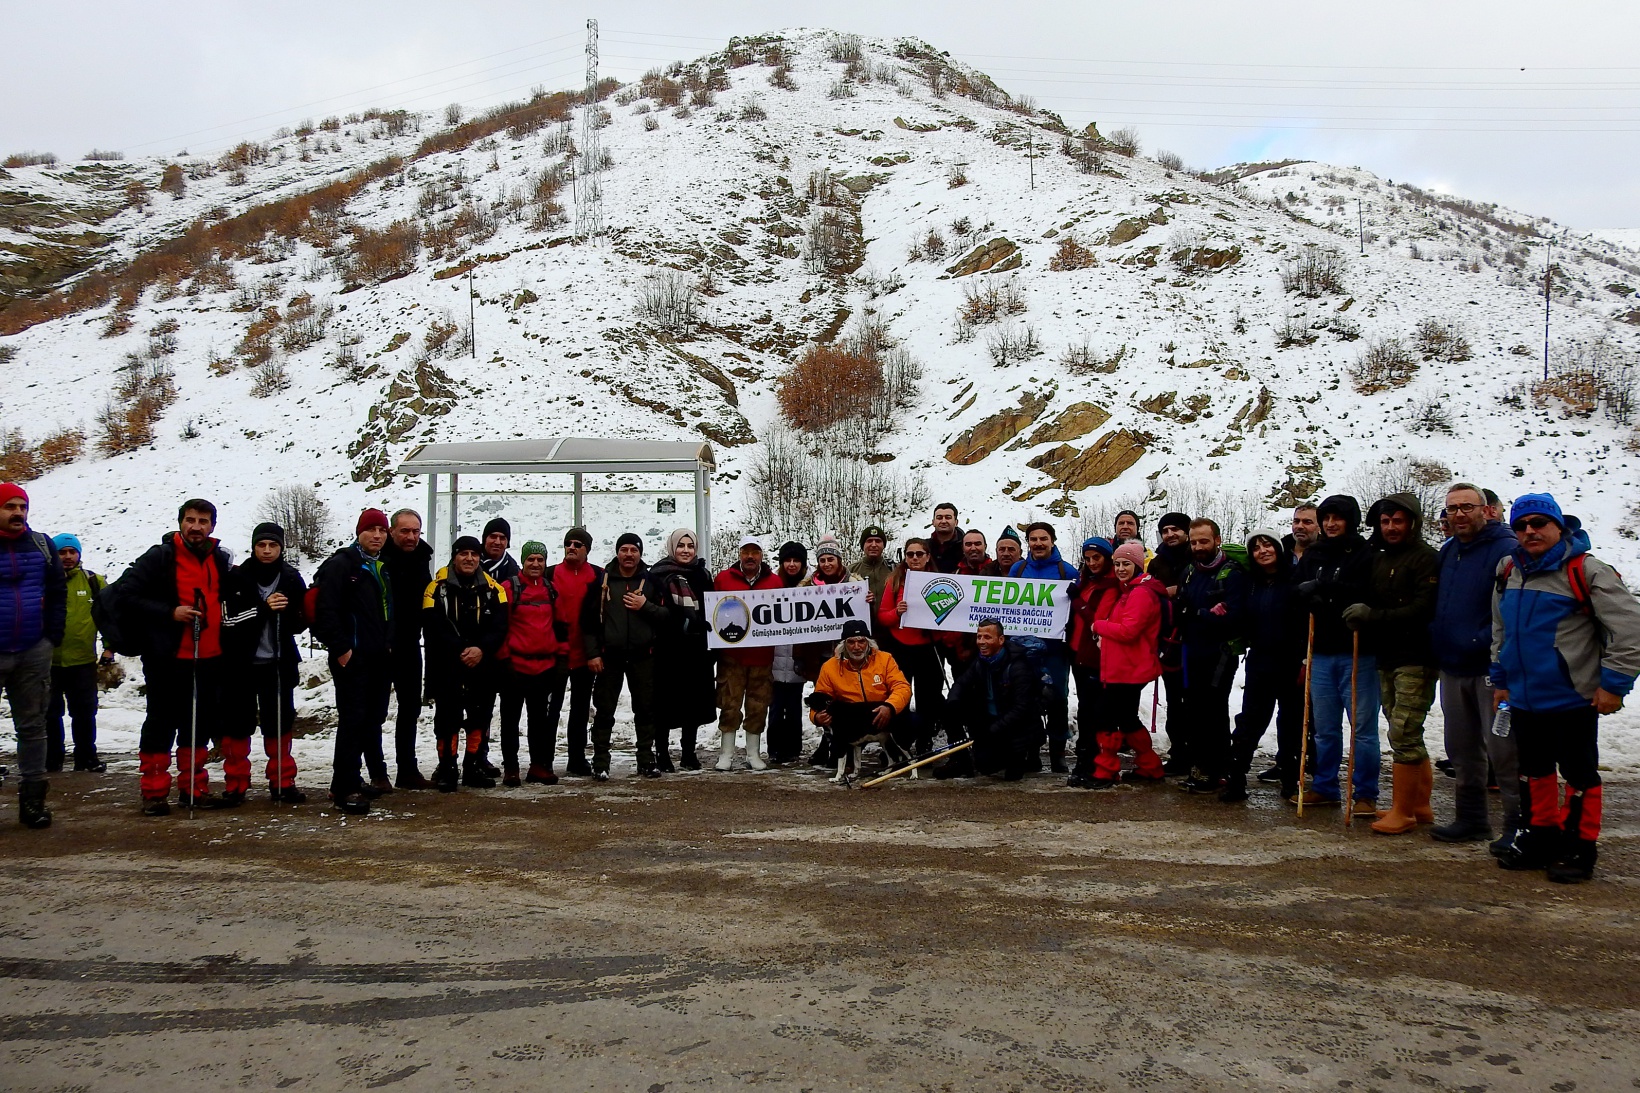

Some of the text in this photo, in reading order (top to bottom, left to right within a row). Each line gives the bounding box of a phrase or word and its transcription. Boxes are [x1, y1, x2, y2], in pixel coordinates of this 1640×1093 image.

[971, 580, 1057, 607] TEDAK
[752, 597, 855, 625] GÜDAK
[970, 606, 1000, 614] TRABZON
[1022, 608, 1053, 617] DAĞCILIK
[752, 630, 781, 638] Gümüşhane
[783, 627, 803, 636] Dağcılık
[811, 625, 823, 633] Doğa
[824, 624, 843, 633] Sporlar
